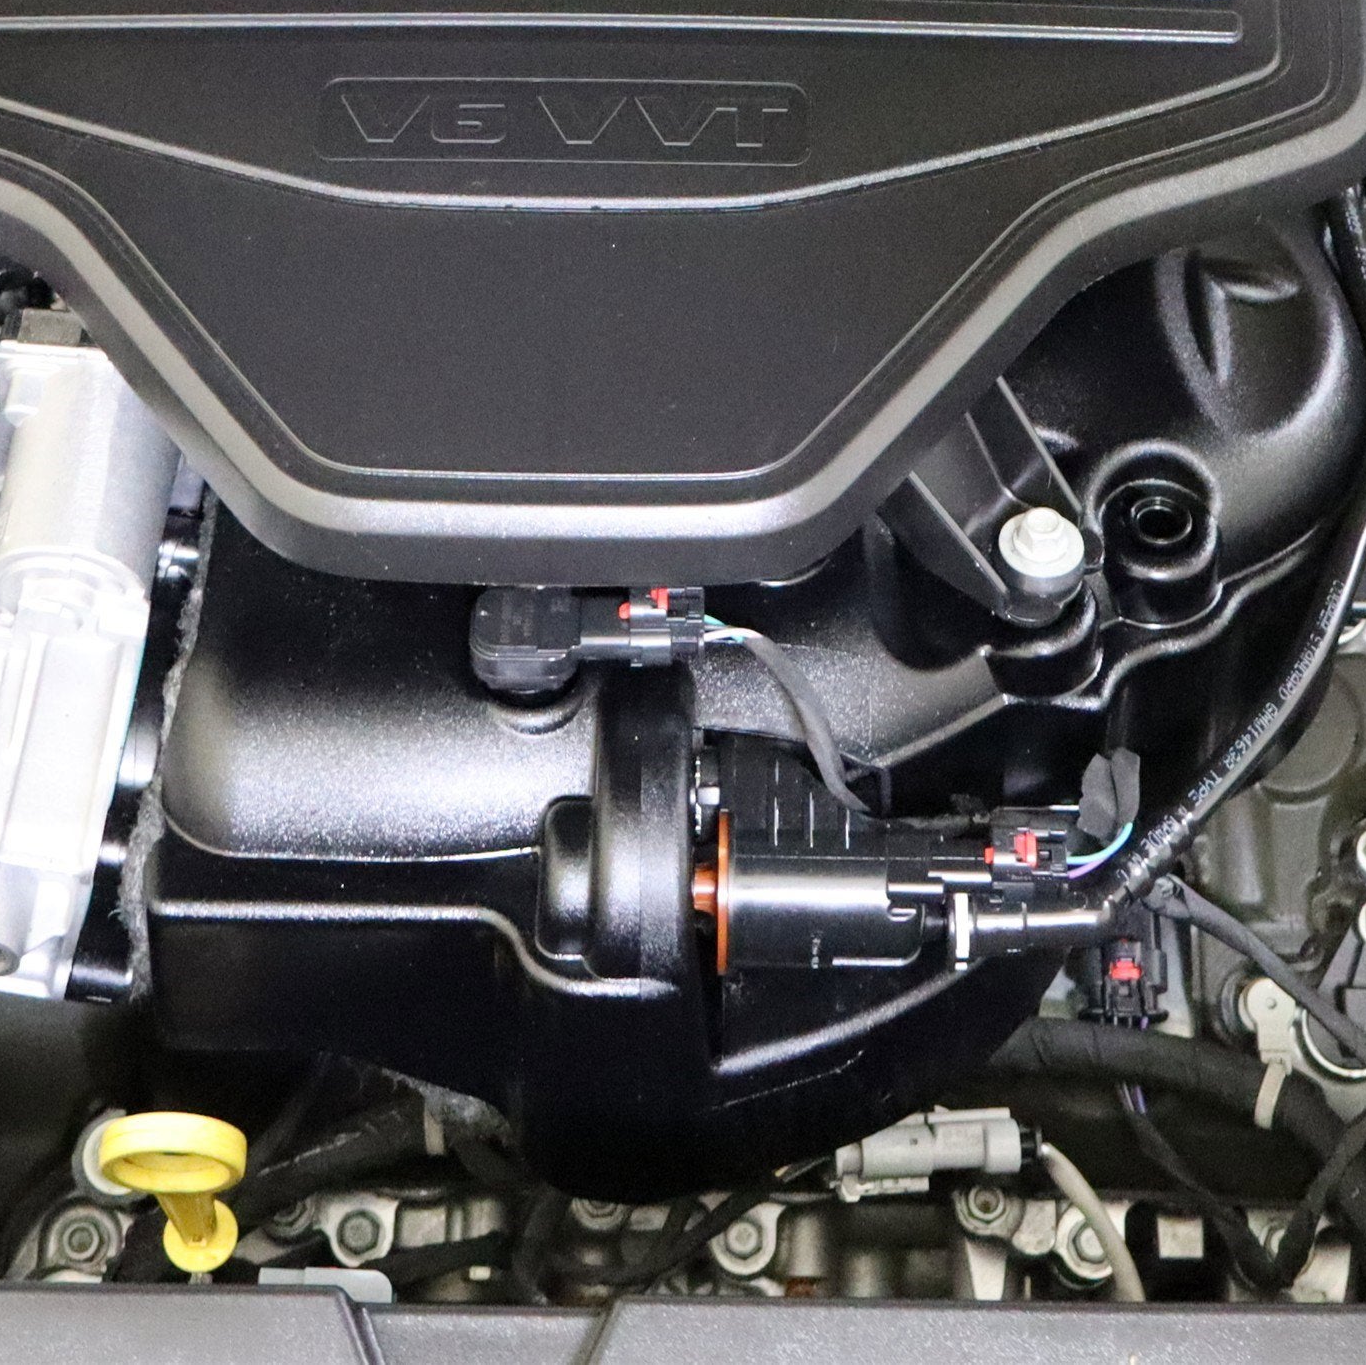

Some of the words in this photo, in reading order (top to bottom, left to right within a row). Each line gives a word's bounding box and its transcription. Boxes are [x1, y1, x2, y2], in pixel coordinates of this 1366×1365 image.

[340, 93, 508, 144] V6
[537, 95, 790, 148] VVT
[1187, 769, 1223, 807] TYPE
